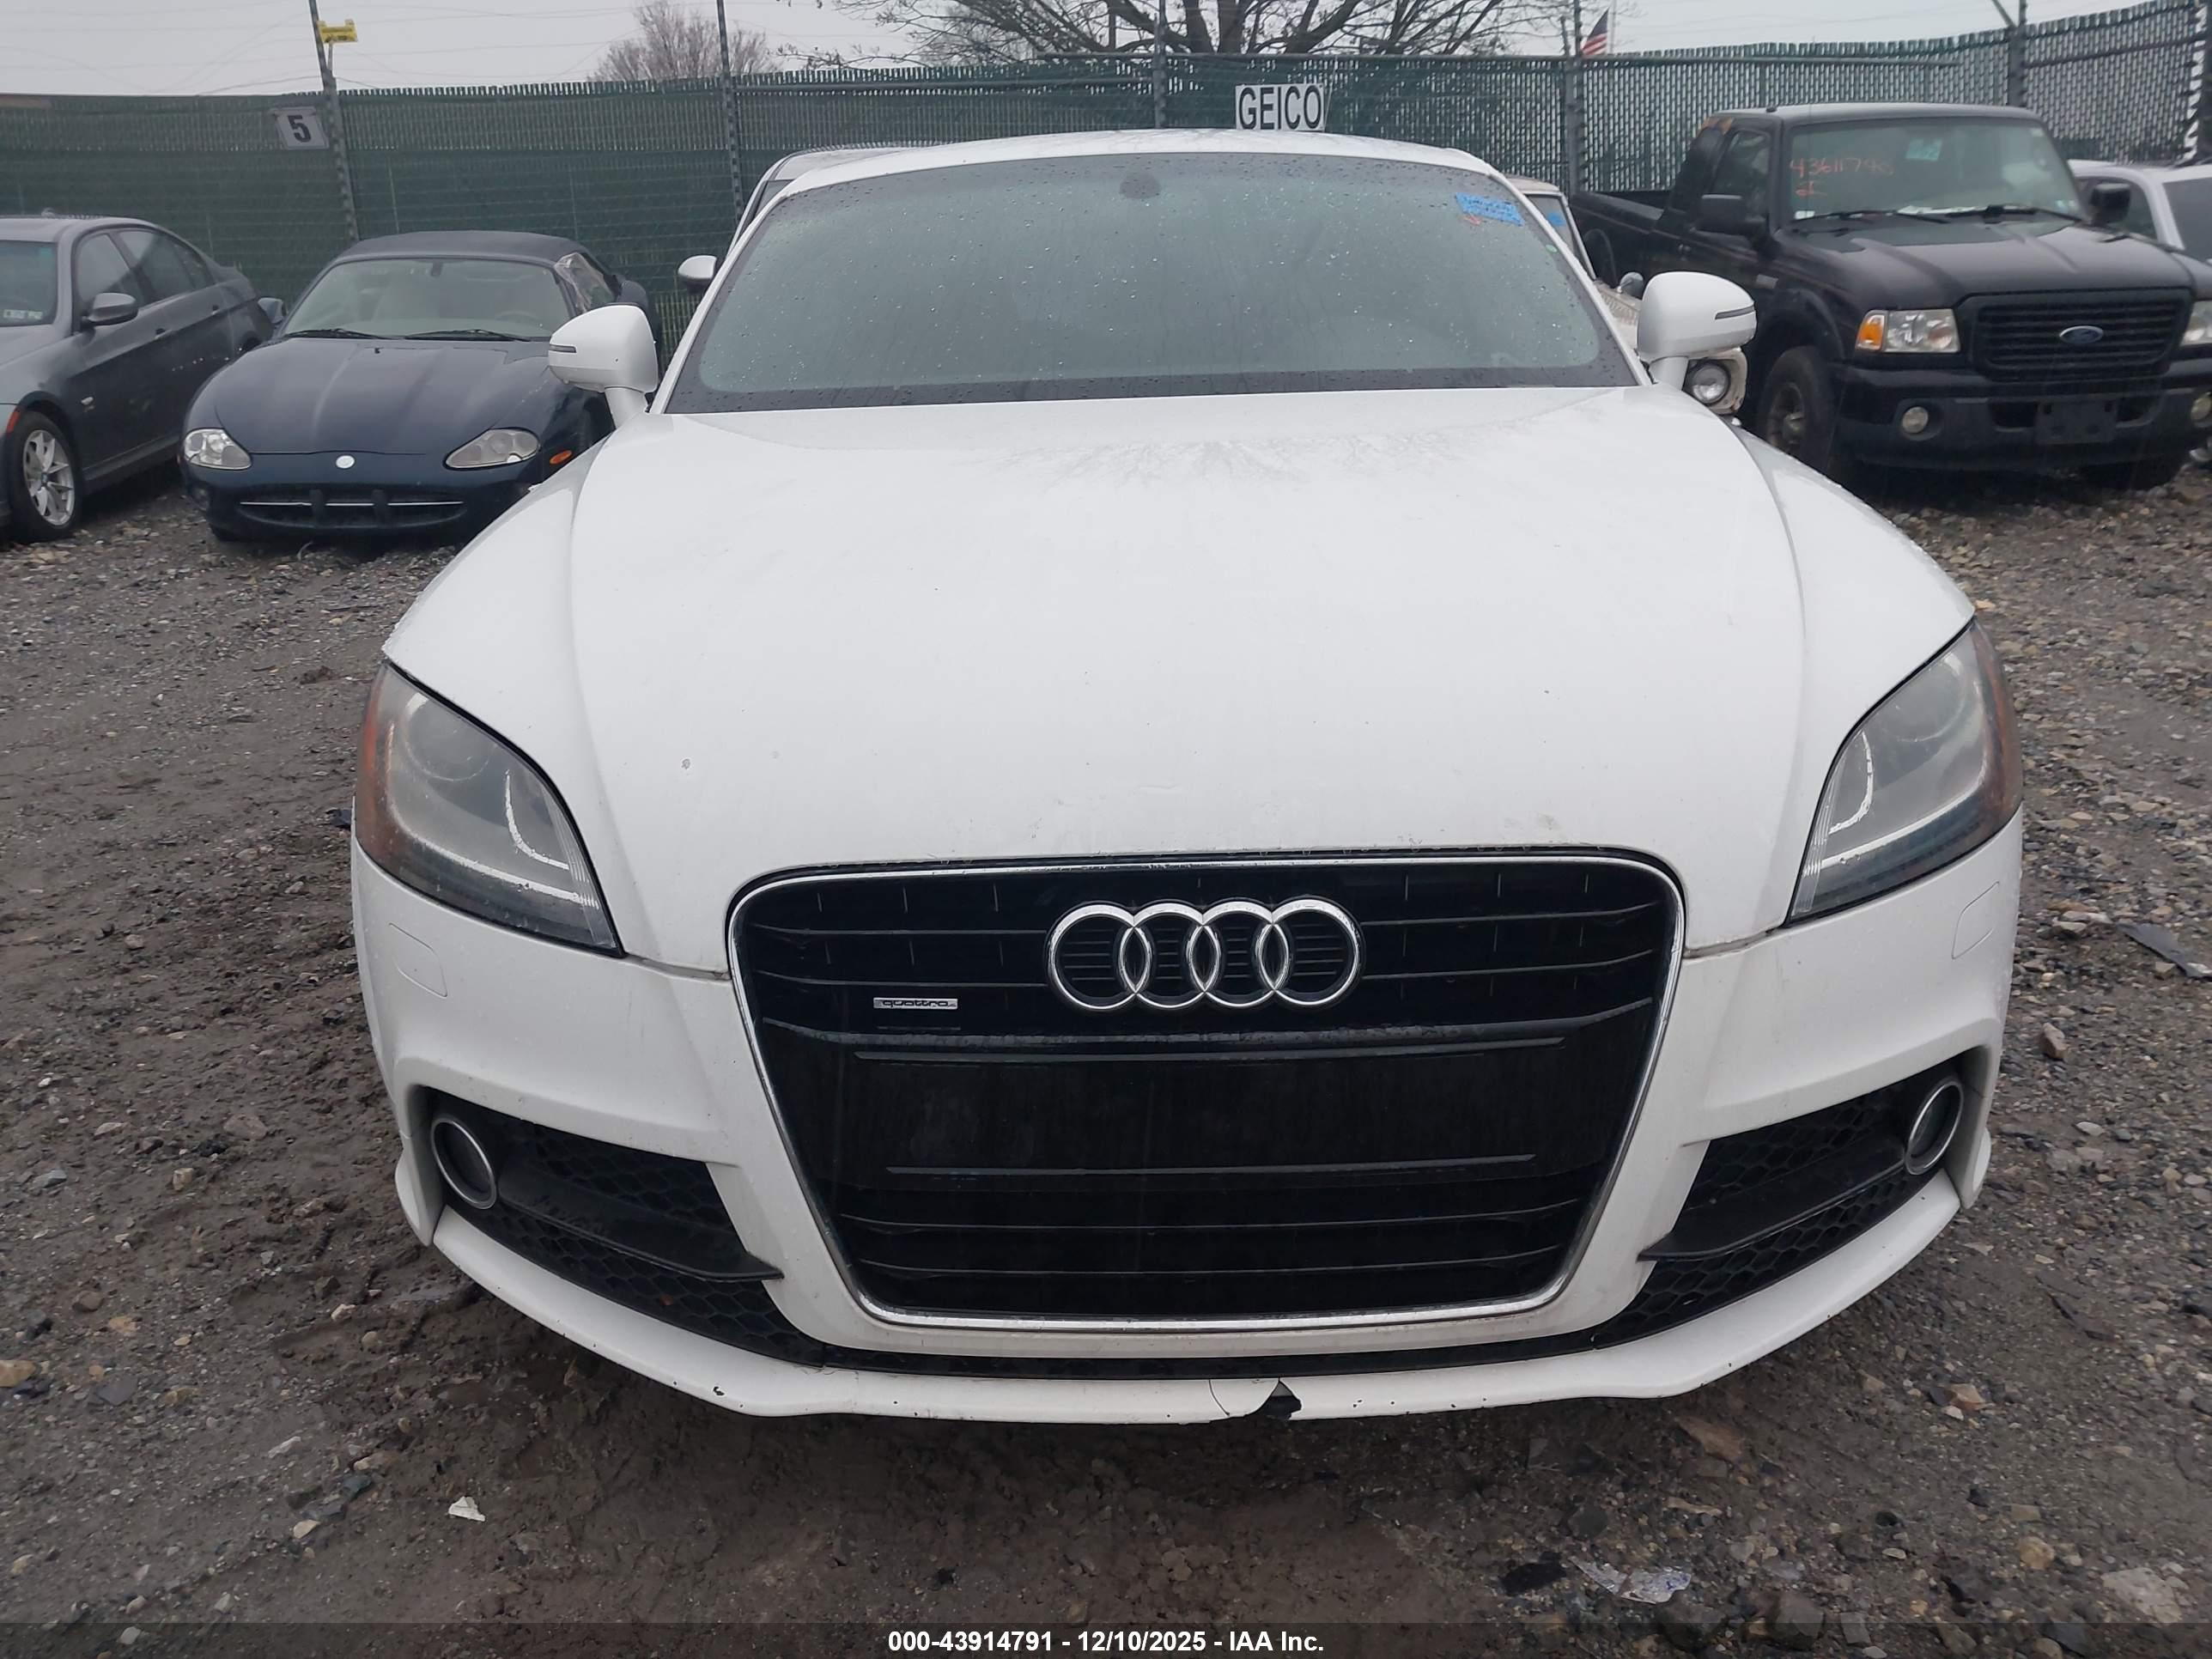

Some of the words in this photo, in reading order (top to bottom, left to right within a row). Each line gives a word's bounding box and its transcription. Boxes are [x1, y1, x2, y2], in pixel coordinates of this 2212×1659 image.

[1239, 85, 1322, 130] GEICO
[288, 114, 311, 143] 5
[882, 1000, 949, 1008] quattro
